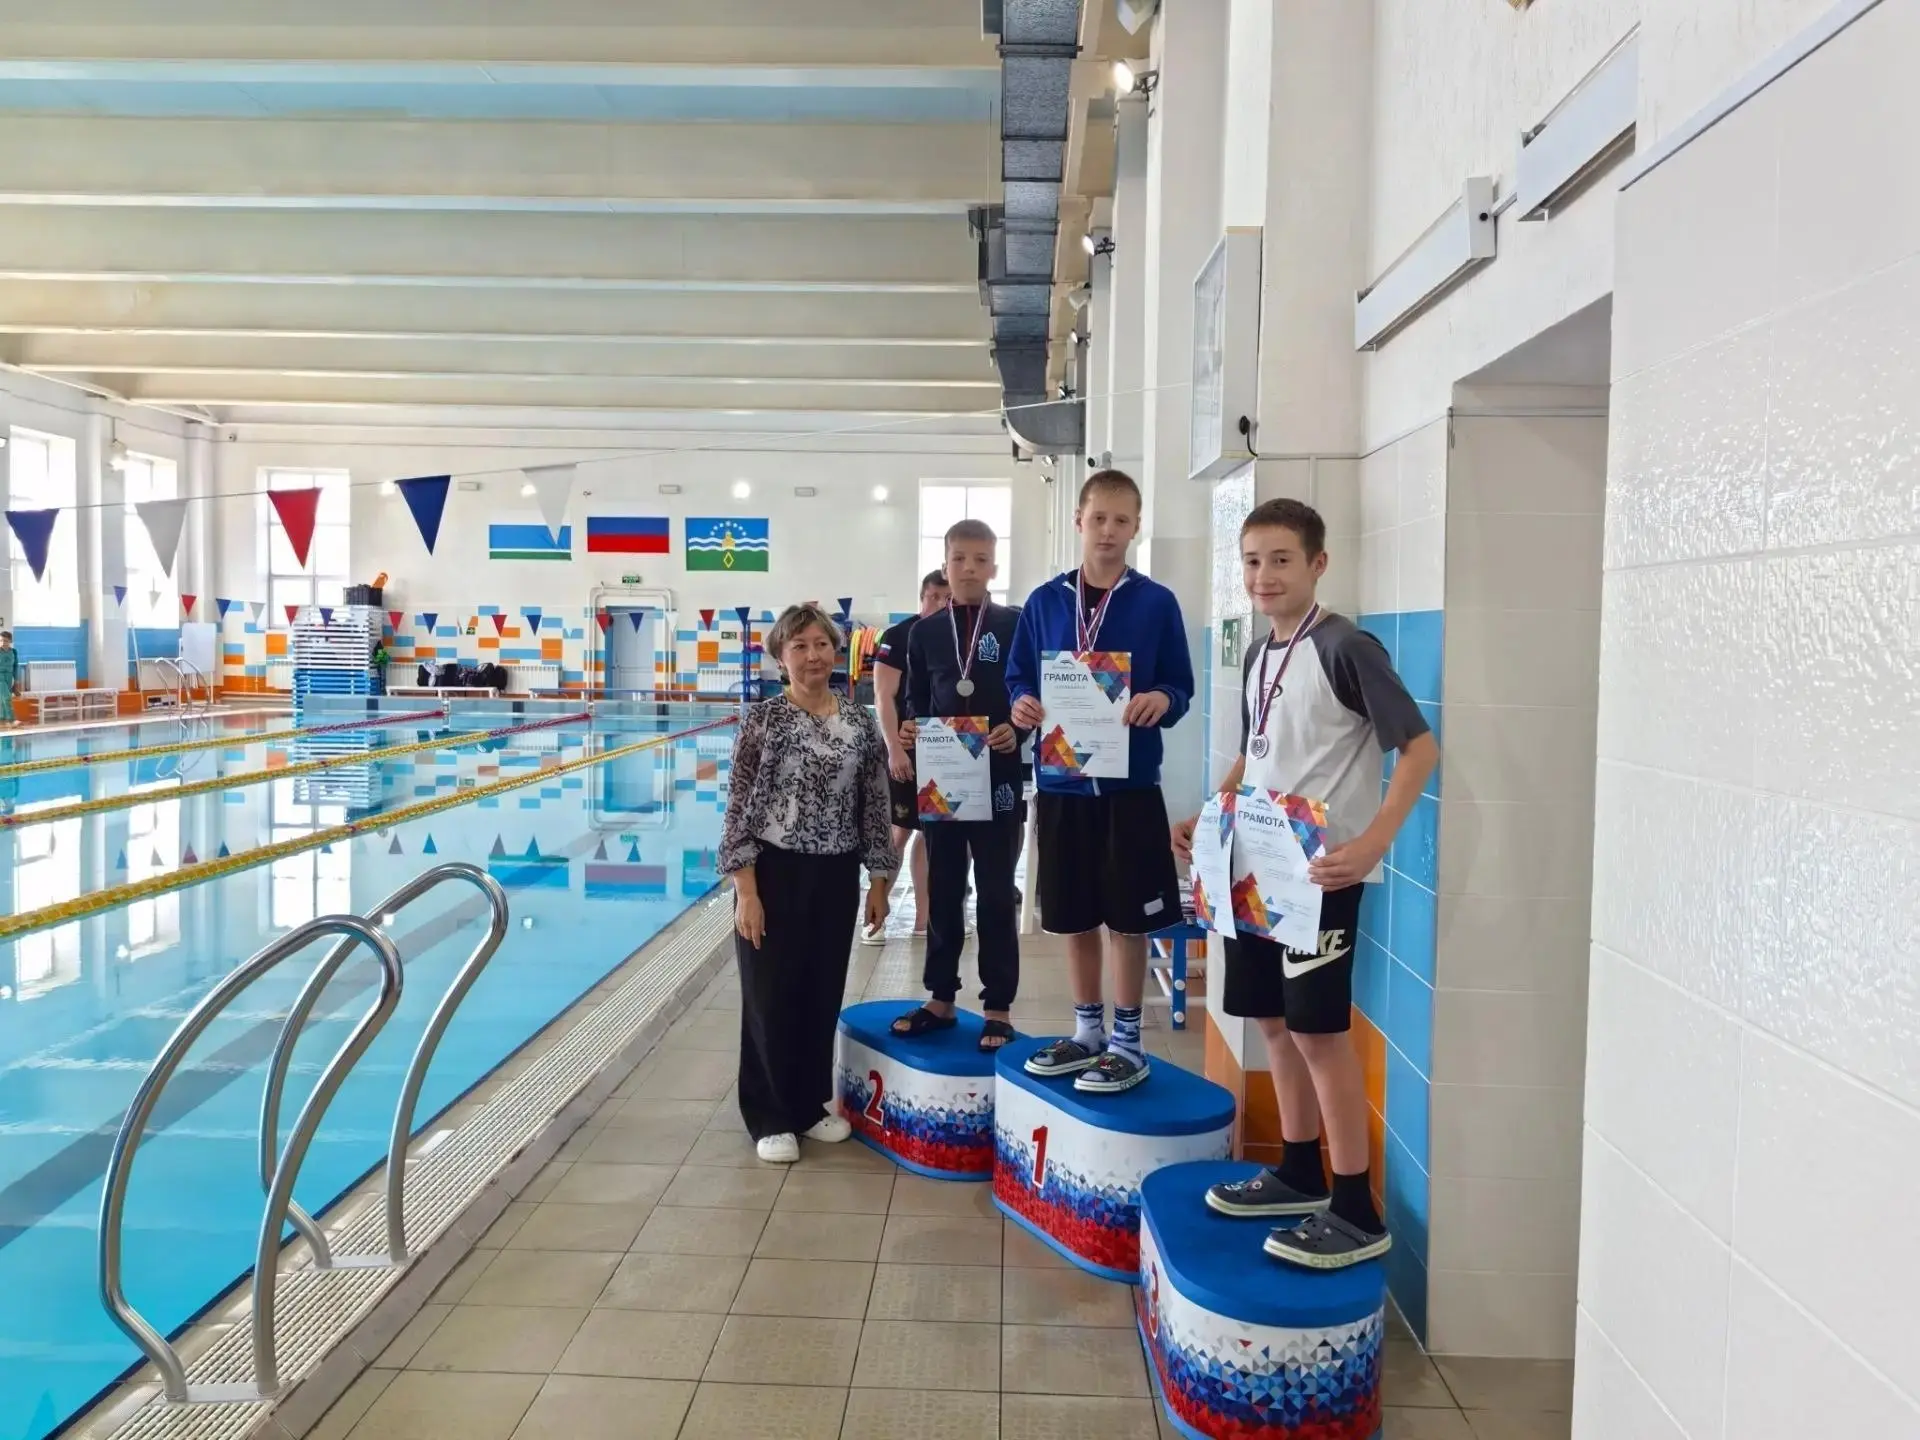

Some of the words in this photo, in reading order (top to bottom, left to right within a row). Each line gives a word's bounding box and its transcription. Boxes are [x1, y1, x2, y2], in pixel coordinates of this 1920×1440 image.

[1044, 673, 1089, 682] ГРАМОТА
[1237, 810, 1286, 829] ГРАМОТА
[1286, 929, 1346, 955] KE
[864, 1069, 884, 1126] 2
[1032, 1125, 1048, 1188] 1
